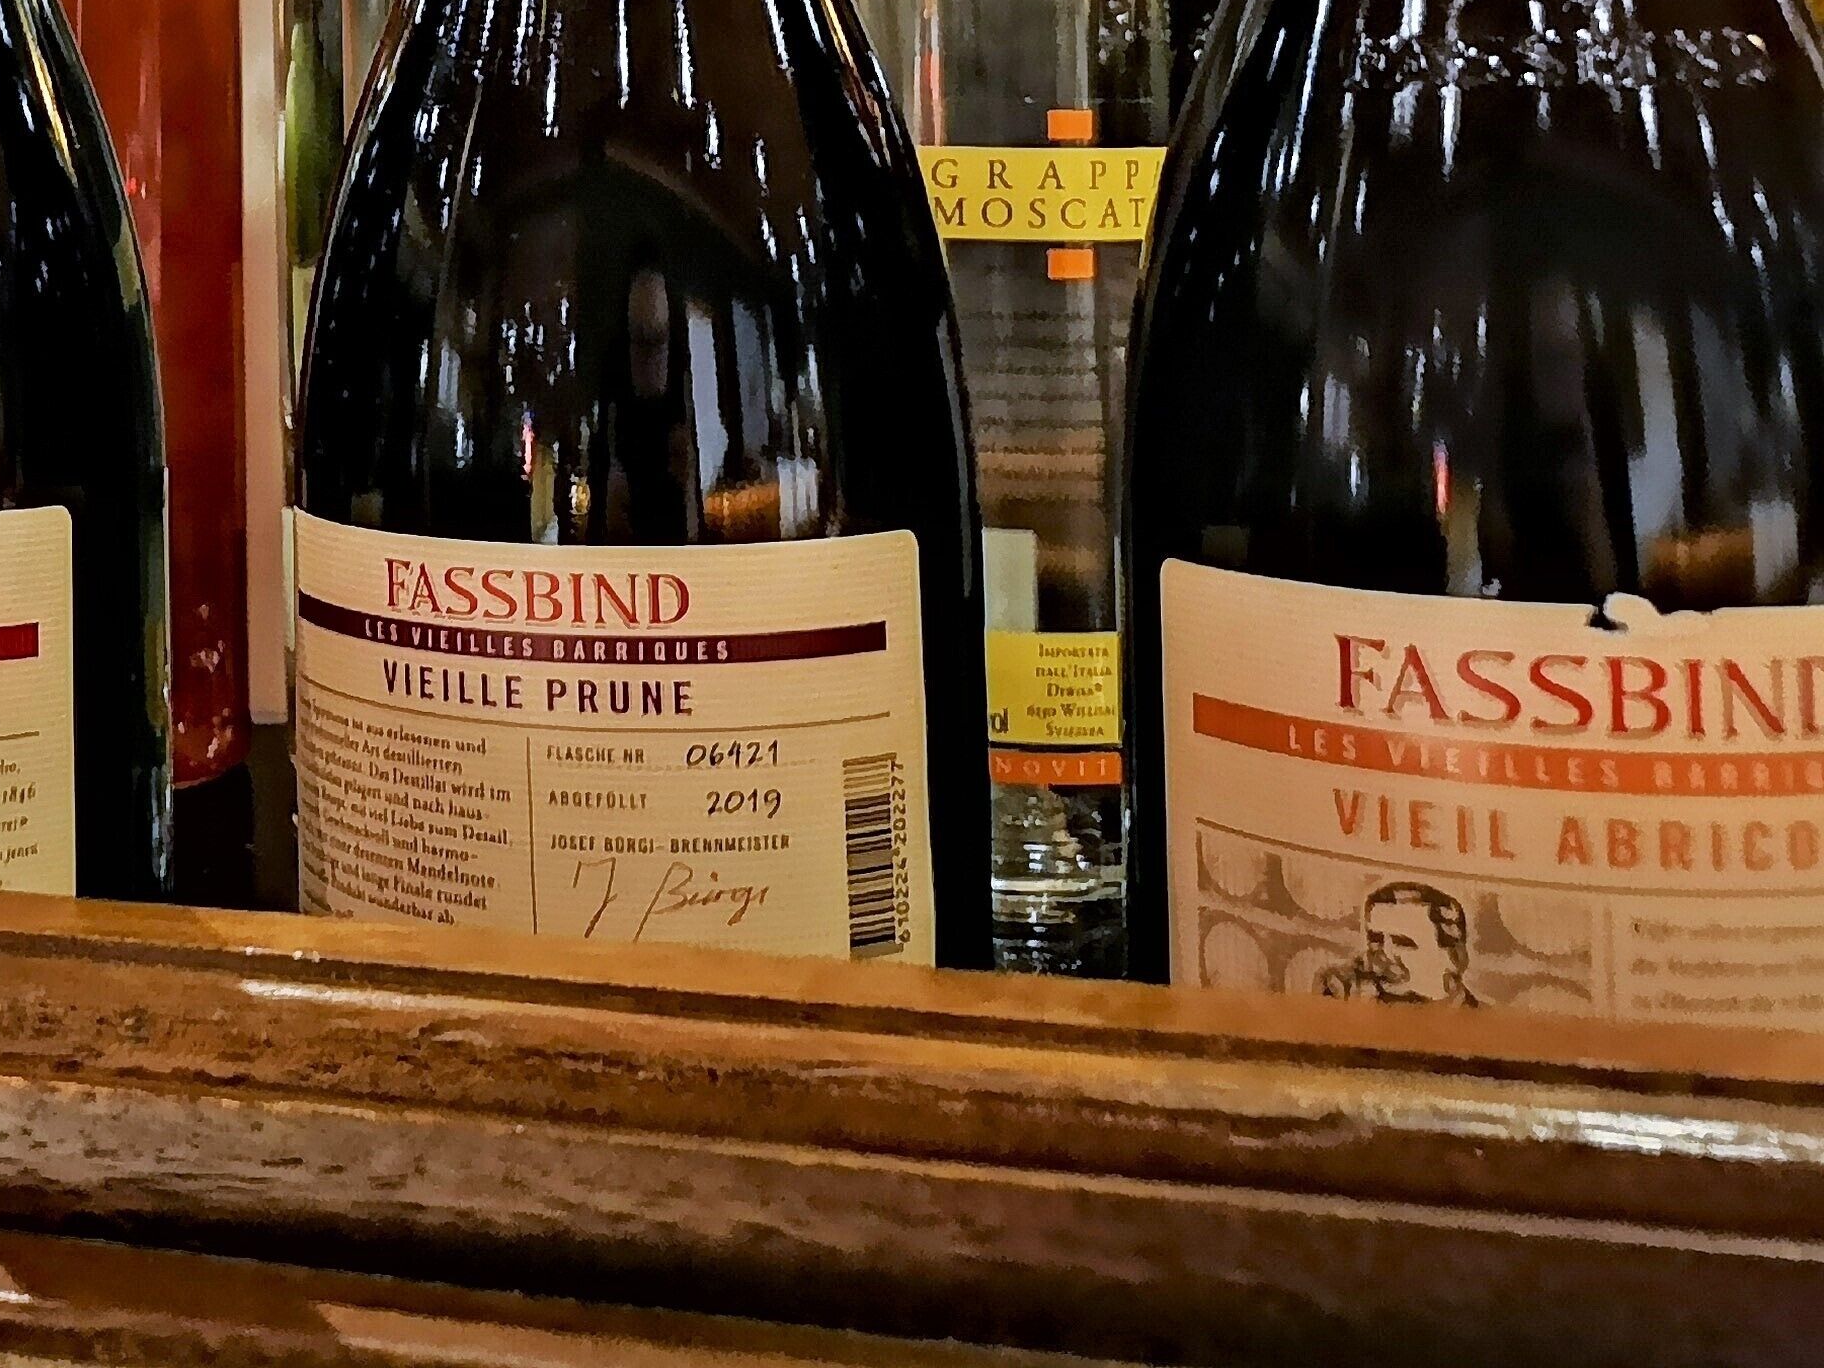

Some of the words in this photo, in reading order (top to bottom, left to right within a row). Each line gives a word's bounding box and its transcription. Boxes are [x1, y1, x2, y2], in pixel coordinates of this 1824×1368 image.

[384, 557, 690, 629] FASSBIND
[365, 619, 397, 642] LES
[412, 626, 533, 658] VIEILLES
[553, 639, 728, 662] BARRIQUES
[383, 658, 523, 709] VIEILLE
[546, 678, 693, 716] PRUNE
[686, 739, 779, 769] 06421
[1288, 724, 1357, 760] LES
[1386, 739, 1621, 788] VIEILLES
[706, 788, 782, 819] 2019
[1332, 787, 1516, 862] VIEIL
[1555, 814, 1821, 872] ABRICO
